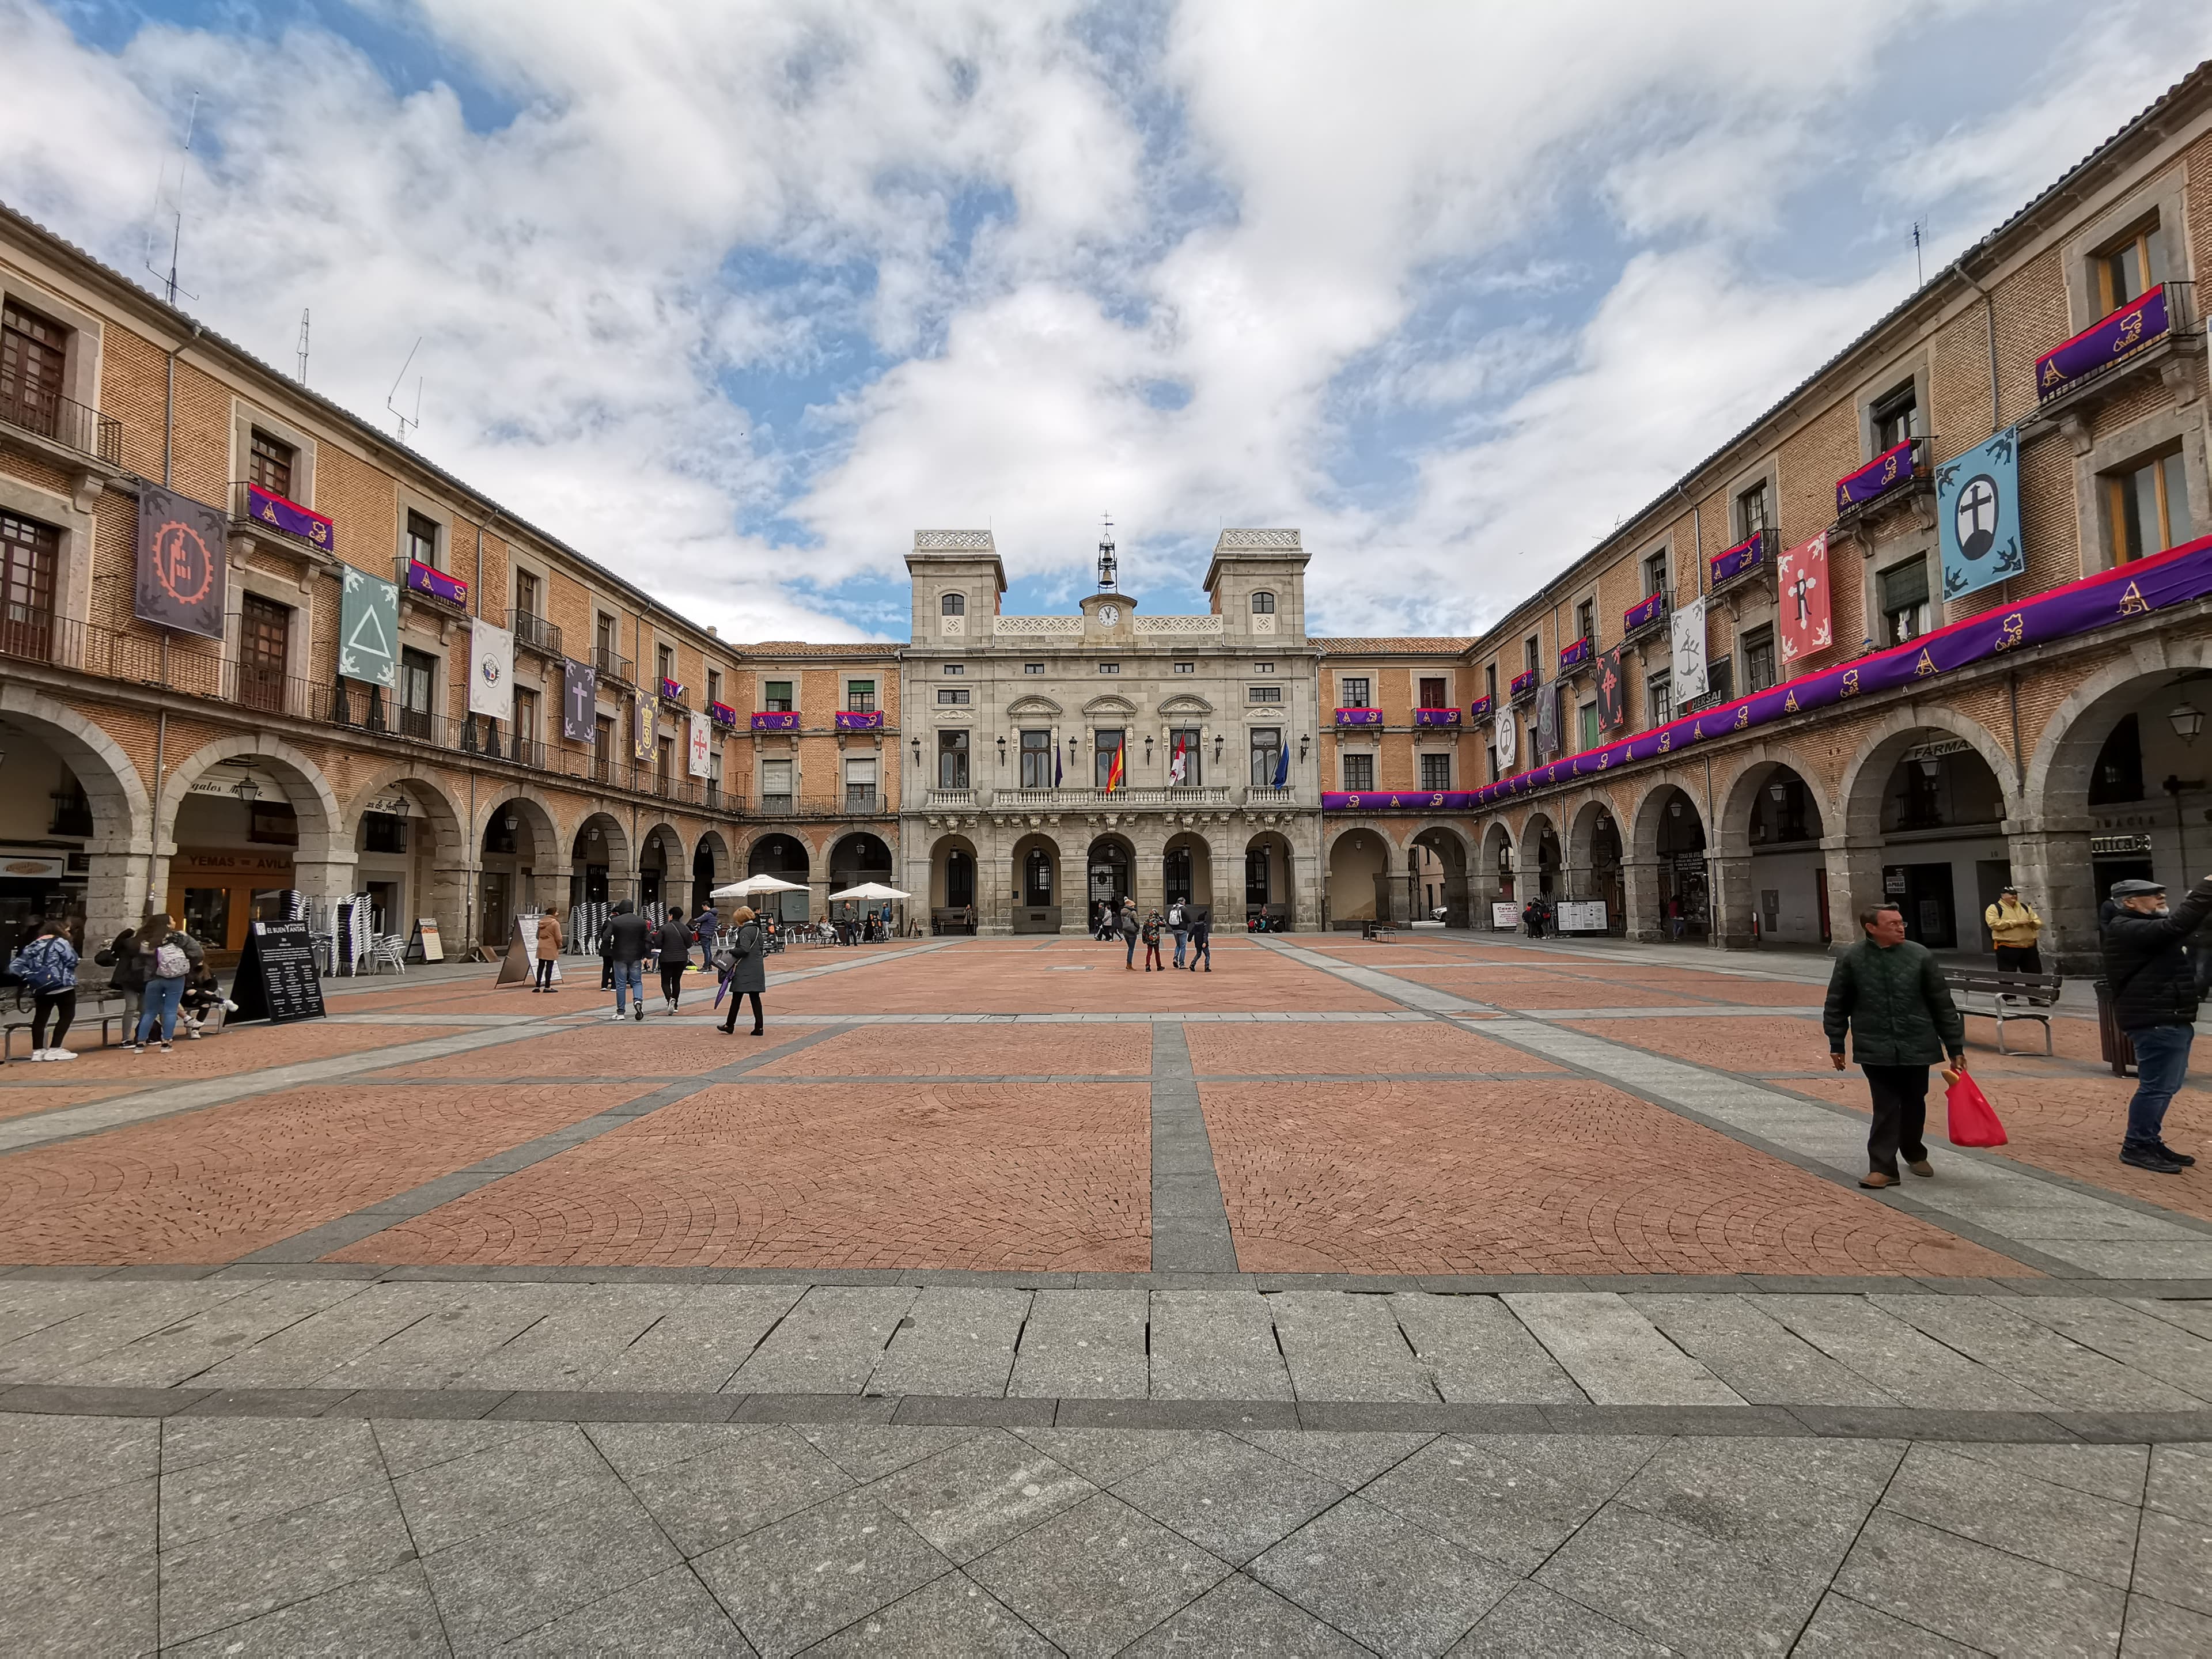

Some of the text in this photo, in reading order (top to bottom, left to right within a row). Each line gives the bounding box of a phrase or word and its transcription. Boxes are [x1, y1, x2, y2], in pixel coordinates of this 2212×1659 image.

[190, 855, 236, 867] YEMAS
[257, 858, 291, 869] AVILA
[285, 924, 306, 933] YANTAR
